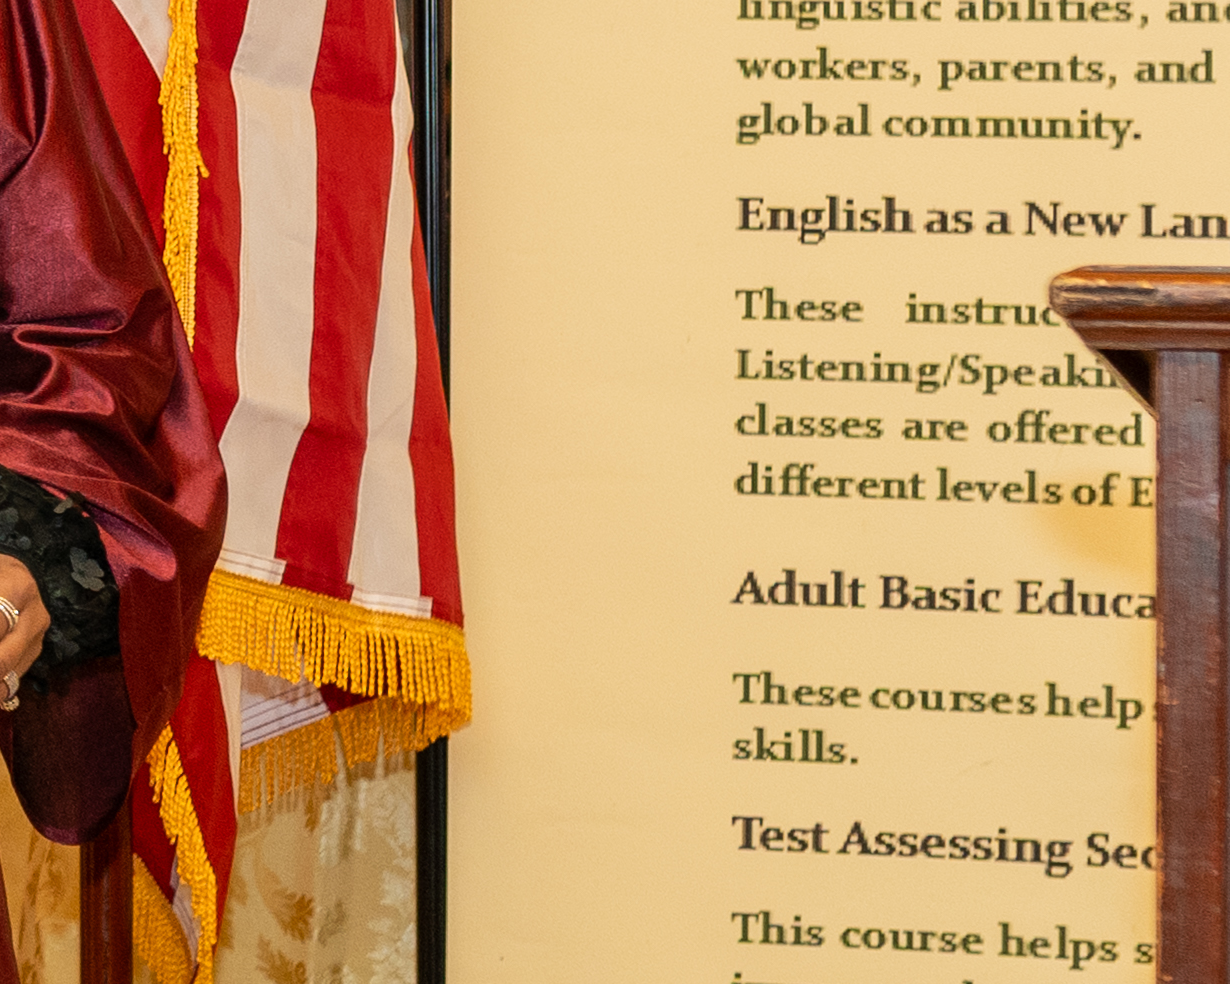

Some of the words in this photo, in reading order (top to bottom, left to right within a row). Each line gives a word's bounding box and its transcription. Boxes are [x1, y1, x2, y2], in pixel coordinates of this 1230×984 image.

[736, 46, 922, 88] workers,
[937, 54, 1118, 91] parents,
[1135, 49, 1215, 84] and
[736, 101, 872, 145] global
[882, 108, 1142, 150] community.
[736, 195, 914, 245] English
[925, 207, 973, 234] as
[986, 208, 1013, 235] a
[1023, 201, 1128, 237] New
[1140, 203, 1230, 239] Lan
[735, 286, 864, 323] These
[735, 402, 884, 441] classes
[902, 416, 969, 442] are
[987, 409, 1144, 447] offered
[735, 462, 925, 501] different
[937, 468, 1062, 505] levels
[1071, 473, 1120, 506] of
[731, 569, 866, 608] Adult
[879, 574, 1002, 613] Basic
[732, 671, 861, 708] These
[870, 687, 1036, 716] courses
[1046, 682, 1145, 730] help
[732, 727, 858, 765] skills.
[731, 816, 829, 853] Test
[836, 821, 1073, 878] Assessing
[731, 911, 826, 947] This
[840, 924, 984, 955] course
[998, 922, 1119, 970] helps
